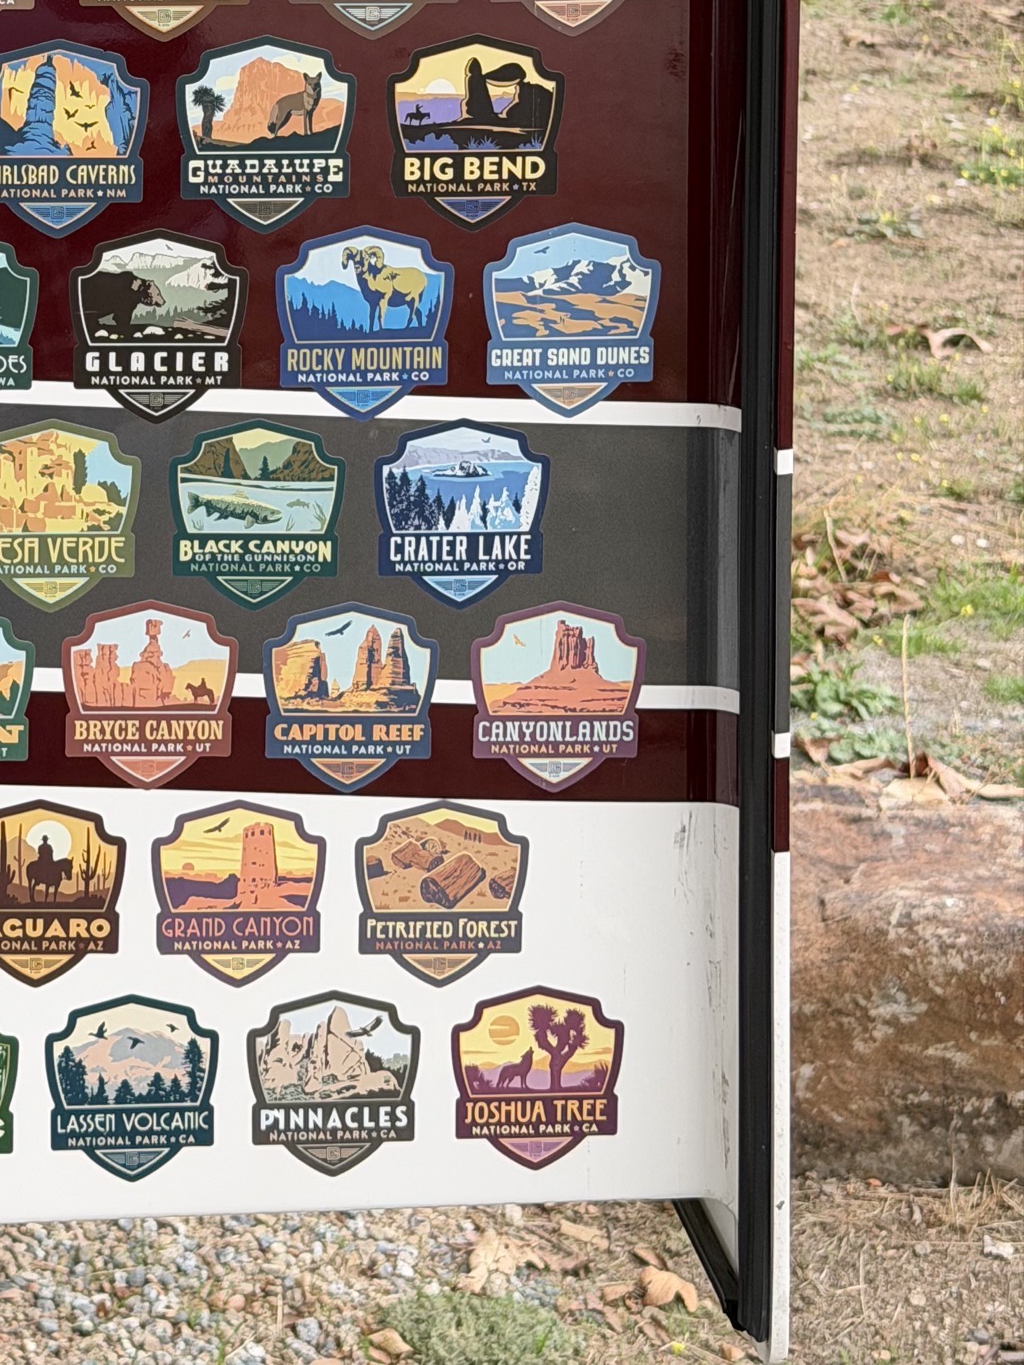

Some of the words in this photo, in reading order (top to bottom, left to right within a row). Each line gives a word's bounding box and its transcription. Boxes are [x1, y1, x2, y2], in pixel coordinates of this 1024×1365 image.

[65, 164, 136, 185] CAVERNS
[188, 158, 344, 184] GUADALUPE
[404, 156, 454, 181] BIG
[463, 155, 546, 180] BEND
[199, 184, 265, 194] NATIONAL
[269, 183, 303, 194] PARK
[314, 183, 333, 193] CO
[207, 174, 324, 184] MOUNTAINS
[85, 351, 229, 372] GLACIER
[287, 347, 346, 372] ROCKY
[351, 346, 442, 371] MOUNTAIN
[491, 348, 543, 367] GREAT
[547, 347, 591, 366] SAND
[596, 346, 650, 365] DUNES
[504, 369, 569, 380] NATIONAL
[573, 368, 605, 379] PARK
[617, 368, 635, 378] CO
[47, 536, 126, 564] VERDE
[179, 539, 242, 562] BLACK
[245, 539, 332, 563] CANYON
[195, 553, 212, 562] OF
[215, 553, 240, 562] THE
[244, 553, 315, 562] GUNNISON
[389, 535, 468, 562] CRATER
[478, 534, 532, 561] LAKE
[190, 562, 255, 572] NATIONAL
[259, 563, 291, 573] PARK
[303, 563, 321, 573] CO
[74, 719, 140, 741] BRYCE
[145, 719, 224, 740] CANYON
[273, 723, 366, 741] CAPITOL
[372, 724, 425, 741] REEF
[478, 720, 634, 742] CANYONLANDS
[491, 744, 555, 755] NATIONAL
[558, 744, 591, 754] PARK
[602, 744, 618, 753] UT
[161, 917, 226, 938] GRAND
[232, 916, 314, 937] CANYON
[366, 918, 453, 939] PETRIFIED
[458, 918, 518, 939] FOREST
[174, 940, 238, 951] NATIONAL
[241, 940, 274, 950] PARK
[285, 939, 300, 949] AZ
[260, 1105, 408, 1131] PINNACLES
[464, 1100, 547, 1124] JOSHUA
[553, 1098, 608, 1122] TREE
[57, 1113, 116, 1134] LASSEN
[122, 1111, 209, 1132] VOLCANIC
